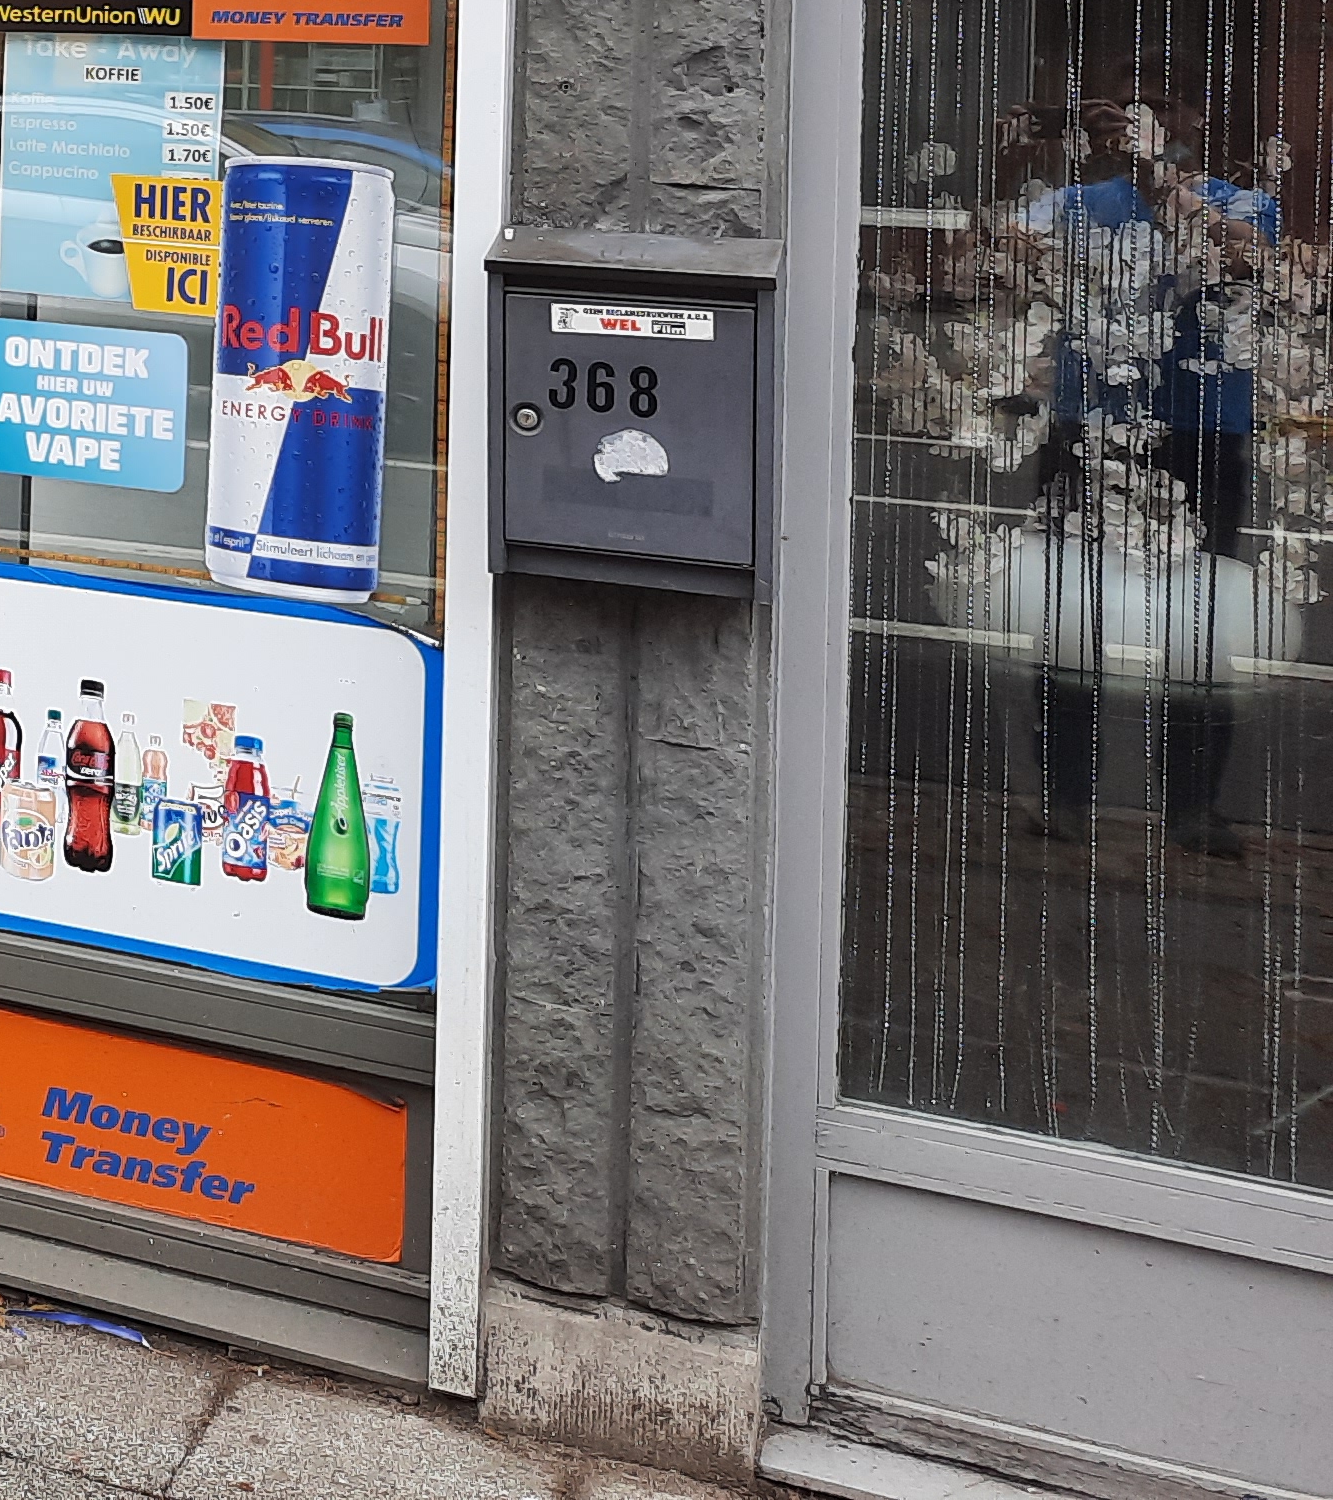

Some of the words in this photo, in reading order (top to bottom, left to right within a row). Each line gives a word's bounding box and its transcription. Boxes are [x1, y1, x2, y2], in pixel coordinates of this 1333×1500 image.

[146, 8, 181, 25] WU
[211, 11, 286, 25] MONEY
[292, 12, 403, 28] TRANSFER
[117, 40, 197, 68] Away
[86, 67, 139, 81] KOFFIE
[169, 96, 214, 109] 1.50€
[10, 116, 77, 131] Espresso
[167, 123, 210, 136] 1.50€
[168, 149, 211, 162] 1.70€
[133, 182, 211, 224] HIER
[132, 224, 211, 241] BESCHIKBAAR
[146, 250, 211, 266] DISPONIBLE
[166, 267, 208, 305] ICI
[222, 304, 300, 353] Red
[309, 311, 383, 363] Bull
[600, 318, 641, 331] WEL
[5, 336, 149, 379] ONTDEK
[36, 374, 78, 394] HIER
[83, 379, 113, 397] UW
[548, 358, 659, 418] 368
[222, 400, 301, 423] ENERGY
[312, 408, 374, 431] DRINK
[26, 431, 121, 472] VAPE
[2, 820, 54, 851] fanta
[225, 801, 267, 858] Oasis
[41, 1087, 211, 1158] Money
[41, 1131, 256, 1205] Transfer
